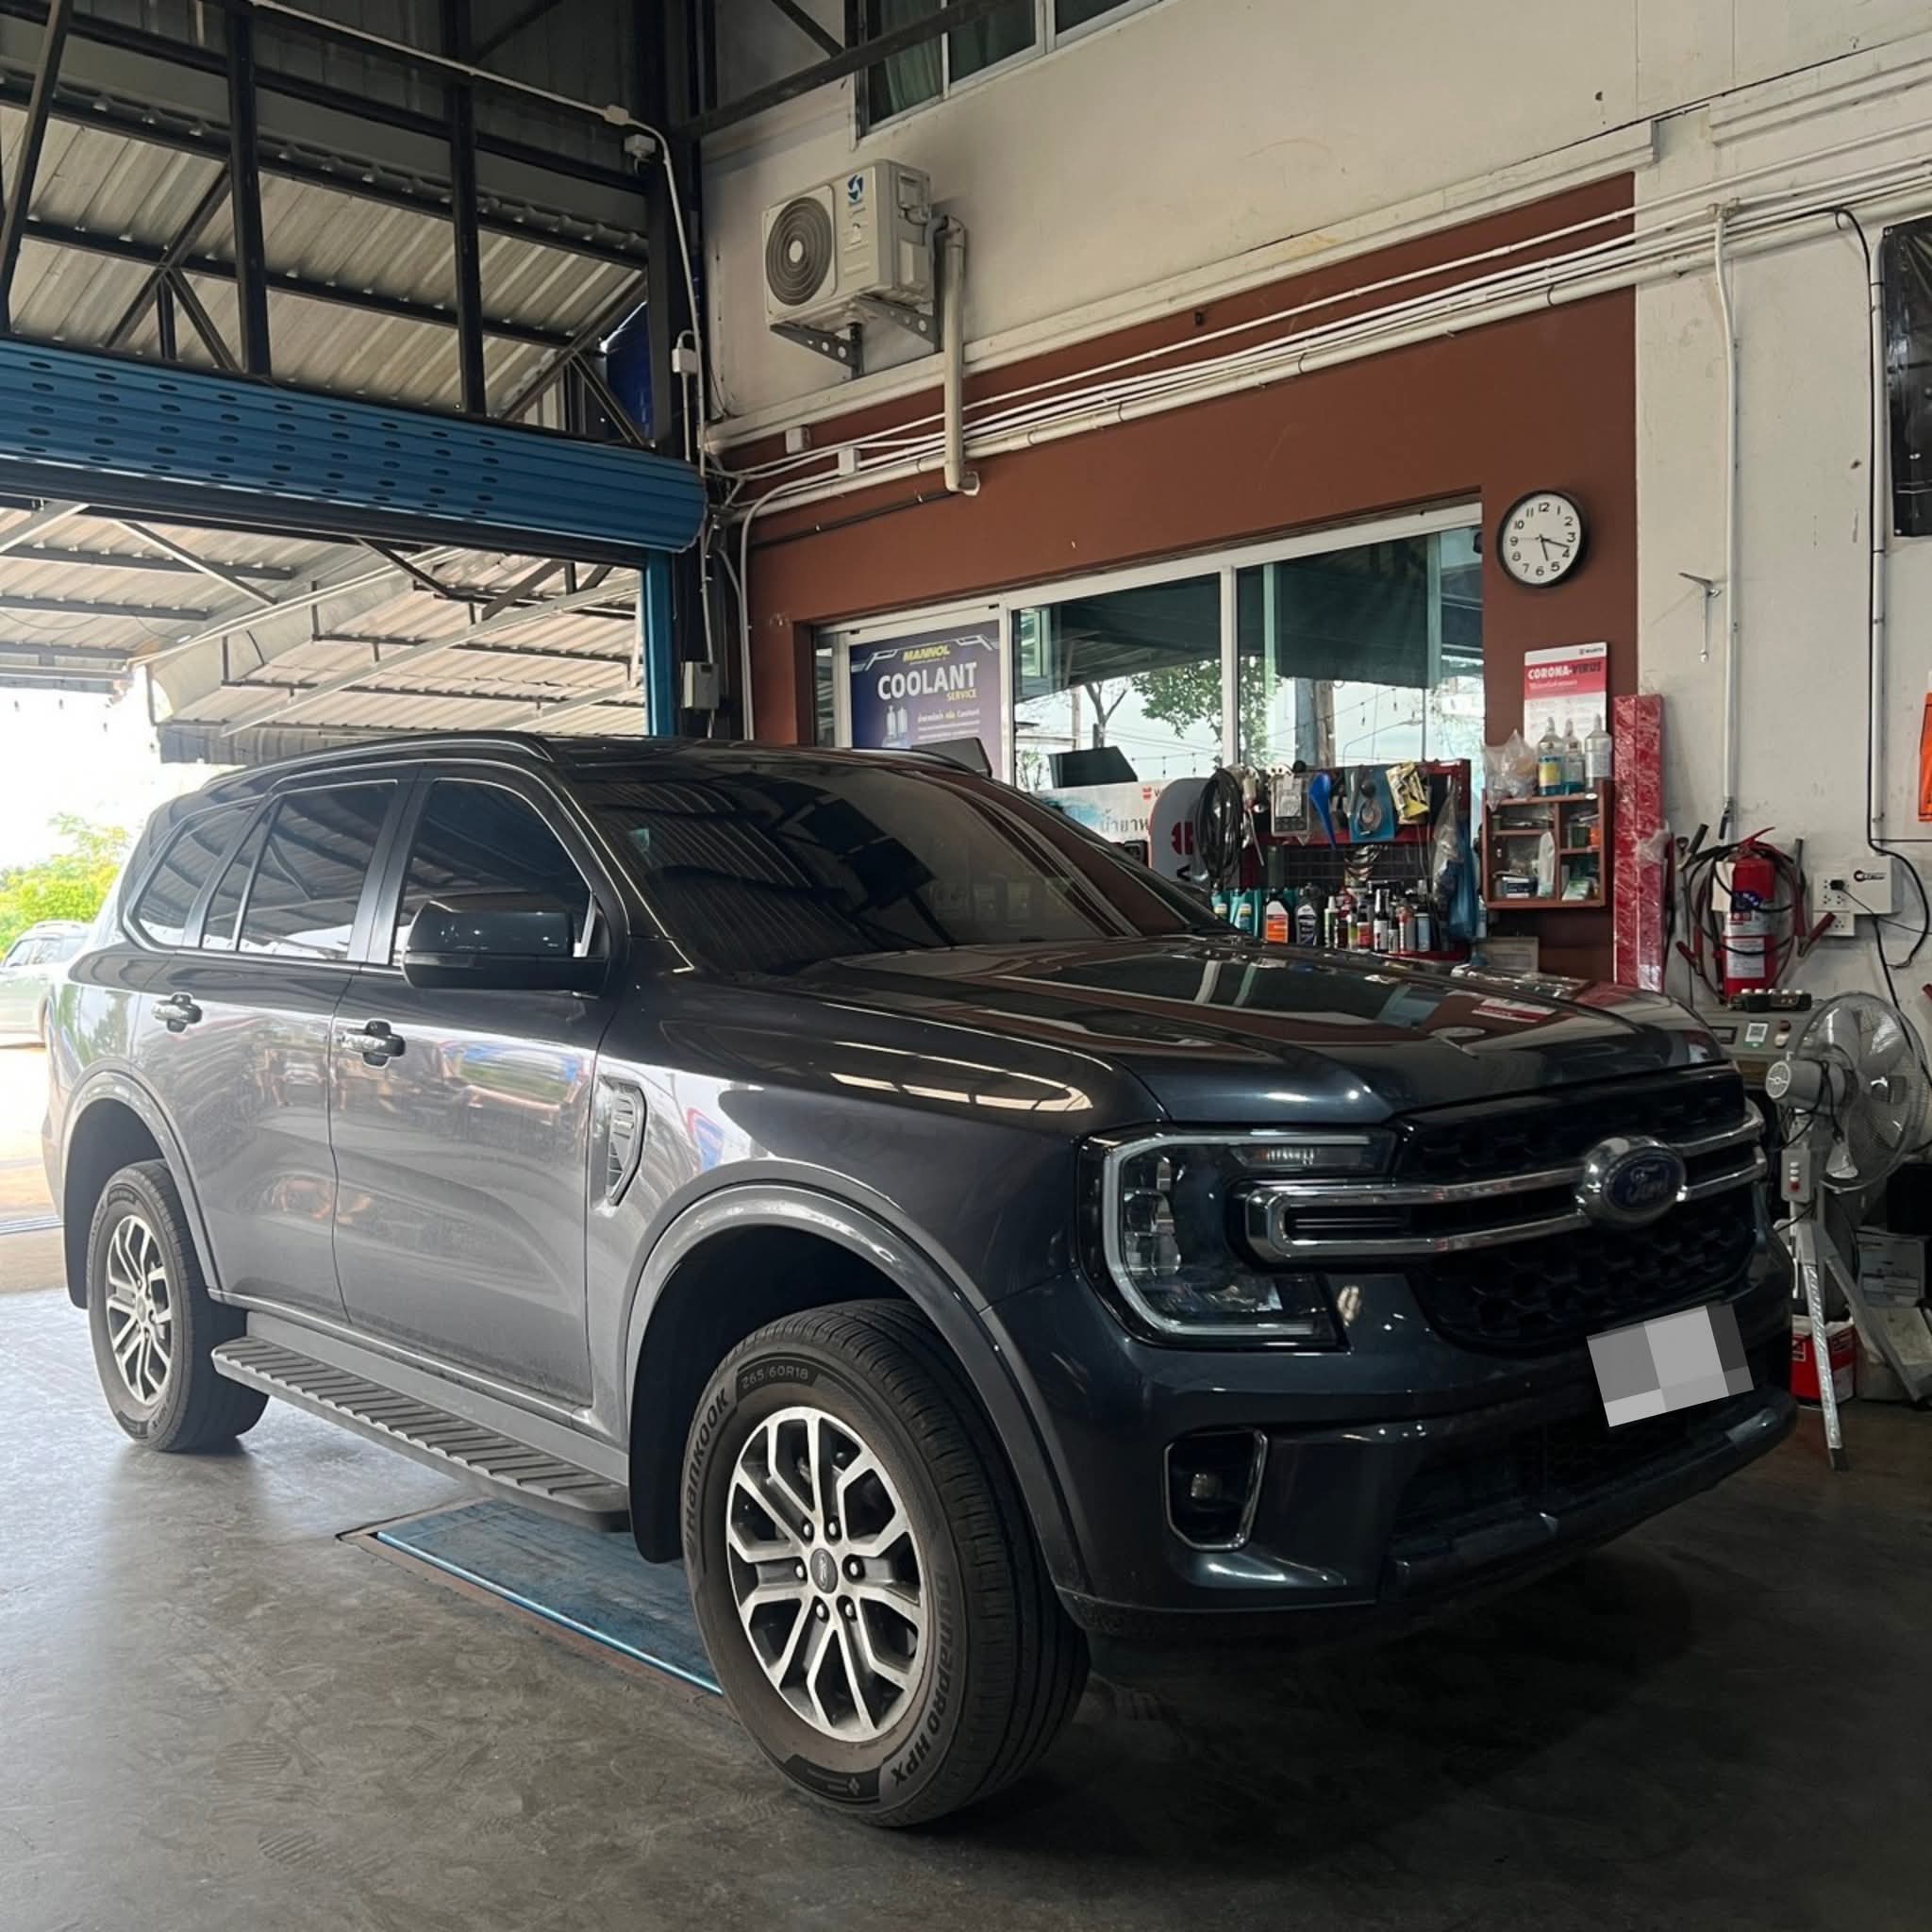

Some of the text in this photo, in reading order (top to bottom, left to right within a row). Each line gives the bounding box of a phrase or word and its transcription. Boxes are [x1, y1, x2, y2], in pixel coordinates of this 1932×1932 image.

[1538, 502, 1550, 512] 12
[1525, 508, 1534, 517] 11
[1513, 520, 1524, 529] 10
[1564, 516, 1574, 526] 2
[1509, 537, 1518, 546] 9
[1567, 532, 1576, 542] 3
[1511, 552, 1521, 561] 8
[1561, 547, 1570, 558] 4
[1522, 563, 1530, 574] 7
[1536, 566, 1544, 575] 6
[1551, 561, 1560, 572] 5
[903, 644, 951, 662] MANNOL
[877, 661, 977, 700] COOLANT
[946, 688, 977, 702] SERVICE
[741, 1365, 808, 1389] 265/60R18
[891, 1733, 931, 1788] HPX
